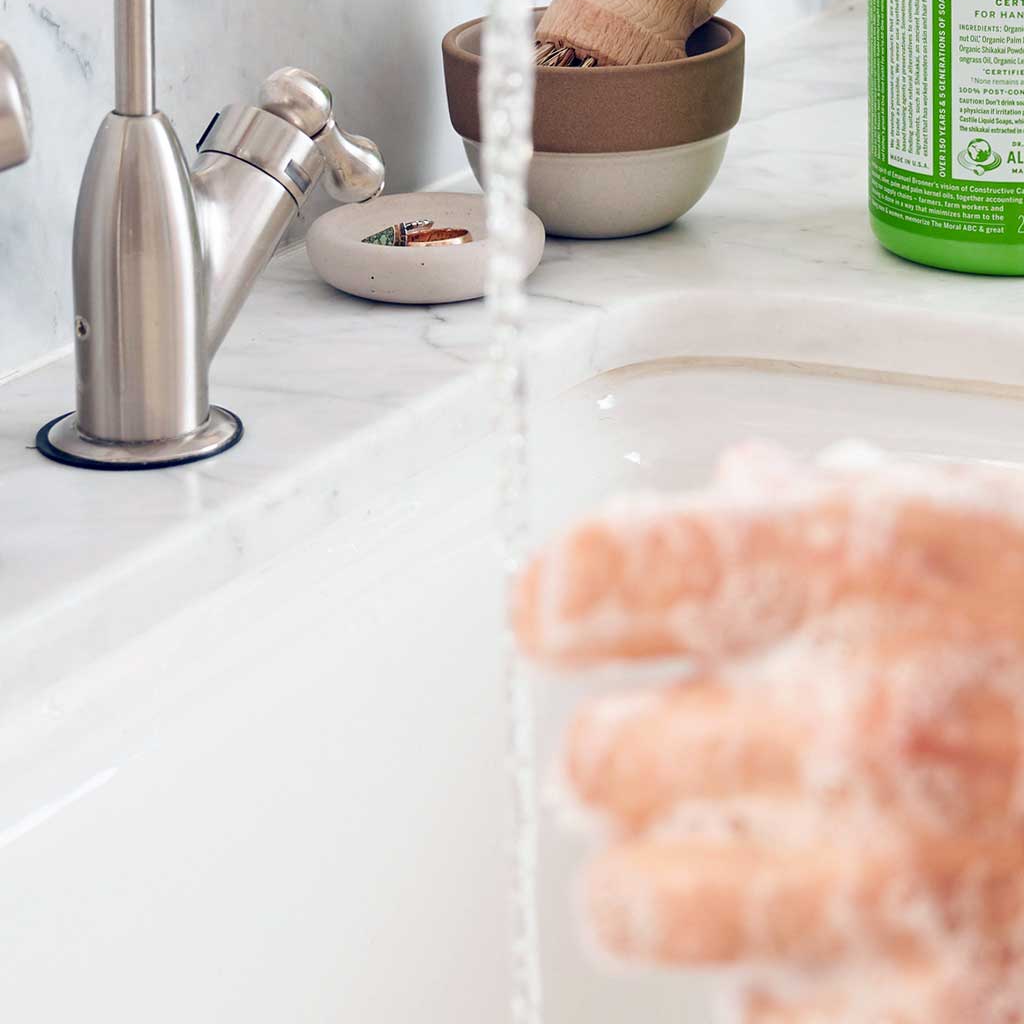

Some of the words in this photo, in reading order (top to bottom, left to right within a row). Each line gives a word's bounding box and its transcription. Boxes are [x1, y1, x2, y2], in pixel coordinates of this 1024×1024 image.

[975, 10, 995, 18] FOR
[938, 17, 945, 28] OF
[960, 24, 1002, 32] INGREDIENTS:
[982, 36, 1005, 44] Organic
[941, 181, 959, 190] vision
[961, 184, 968, 192] of
[970, 185, 1014, 195] Constructive
[957, 193, 984, 202] together
[985, 196, 1023, 205] accounting
[945, 201, 960, 209] farm
[962, 203, 989, 211] workers
[928, 207, 960, 218] minimizes
[962, 212, 980, 220] harm
[931, 220, 942, 228] The
[944, 222, 961, 231] Moral
[986, 227, 1004, 235] great
